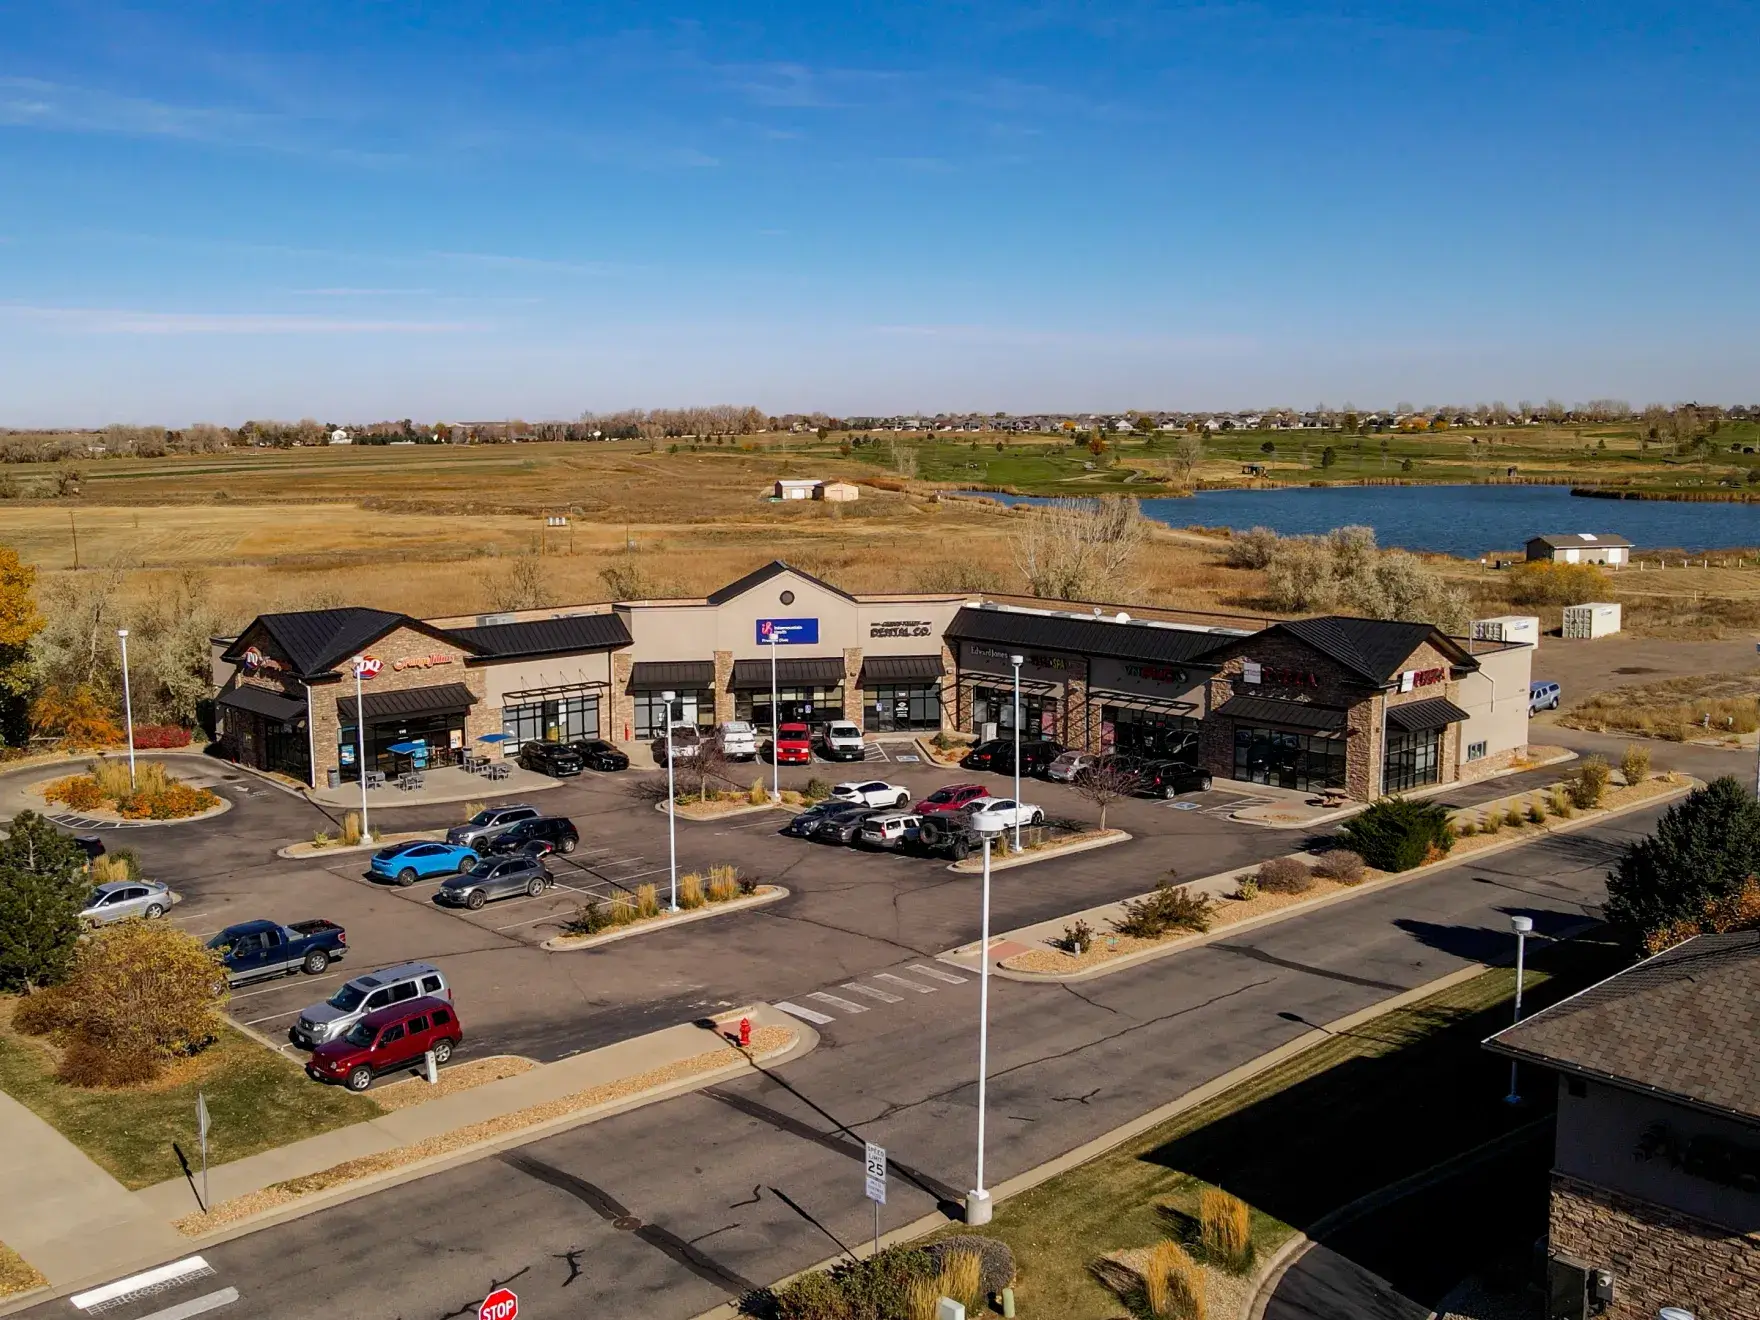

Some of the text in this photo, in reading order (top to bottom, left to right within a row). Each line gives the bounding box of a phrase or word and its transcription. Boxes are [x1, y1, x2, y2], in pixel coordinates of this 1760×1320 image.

[870, 627, 910, 638] DENTAL
[970, 645, 1008, 658] Edward Jones
[358, 659, 381, 673] DQ
[867, 1145, 885, 1158] SPEED
[868, 1153, 883, 1162] LIMIT
[868, 1160, 884, 1177] 25
[482, 1299, 515, 1320] STOP
